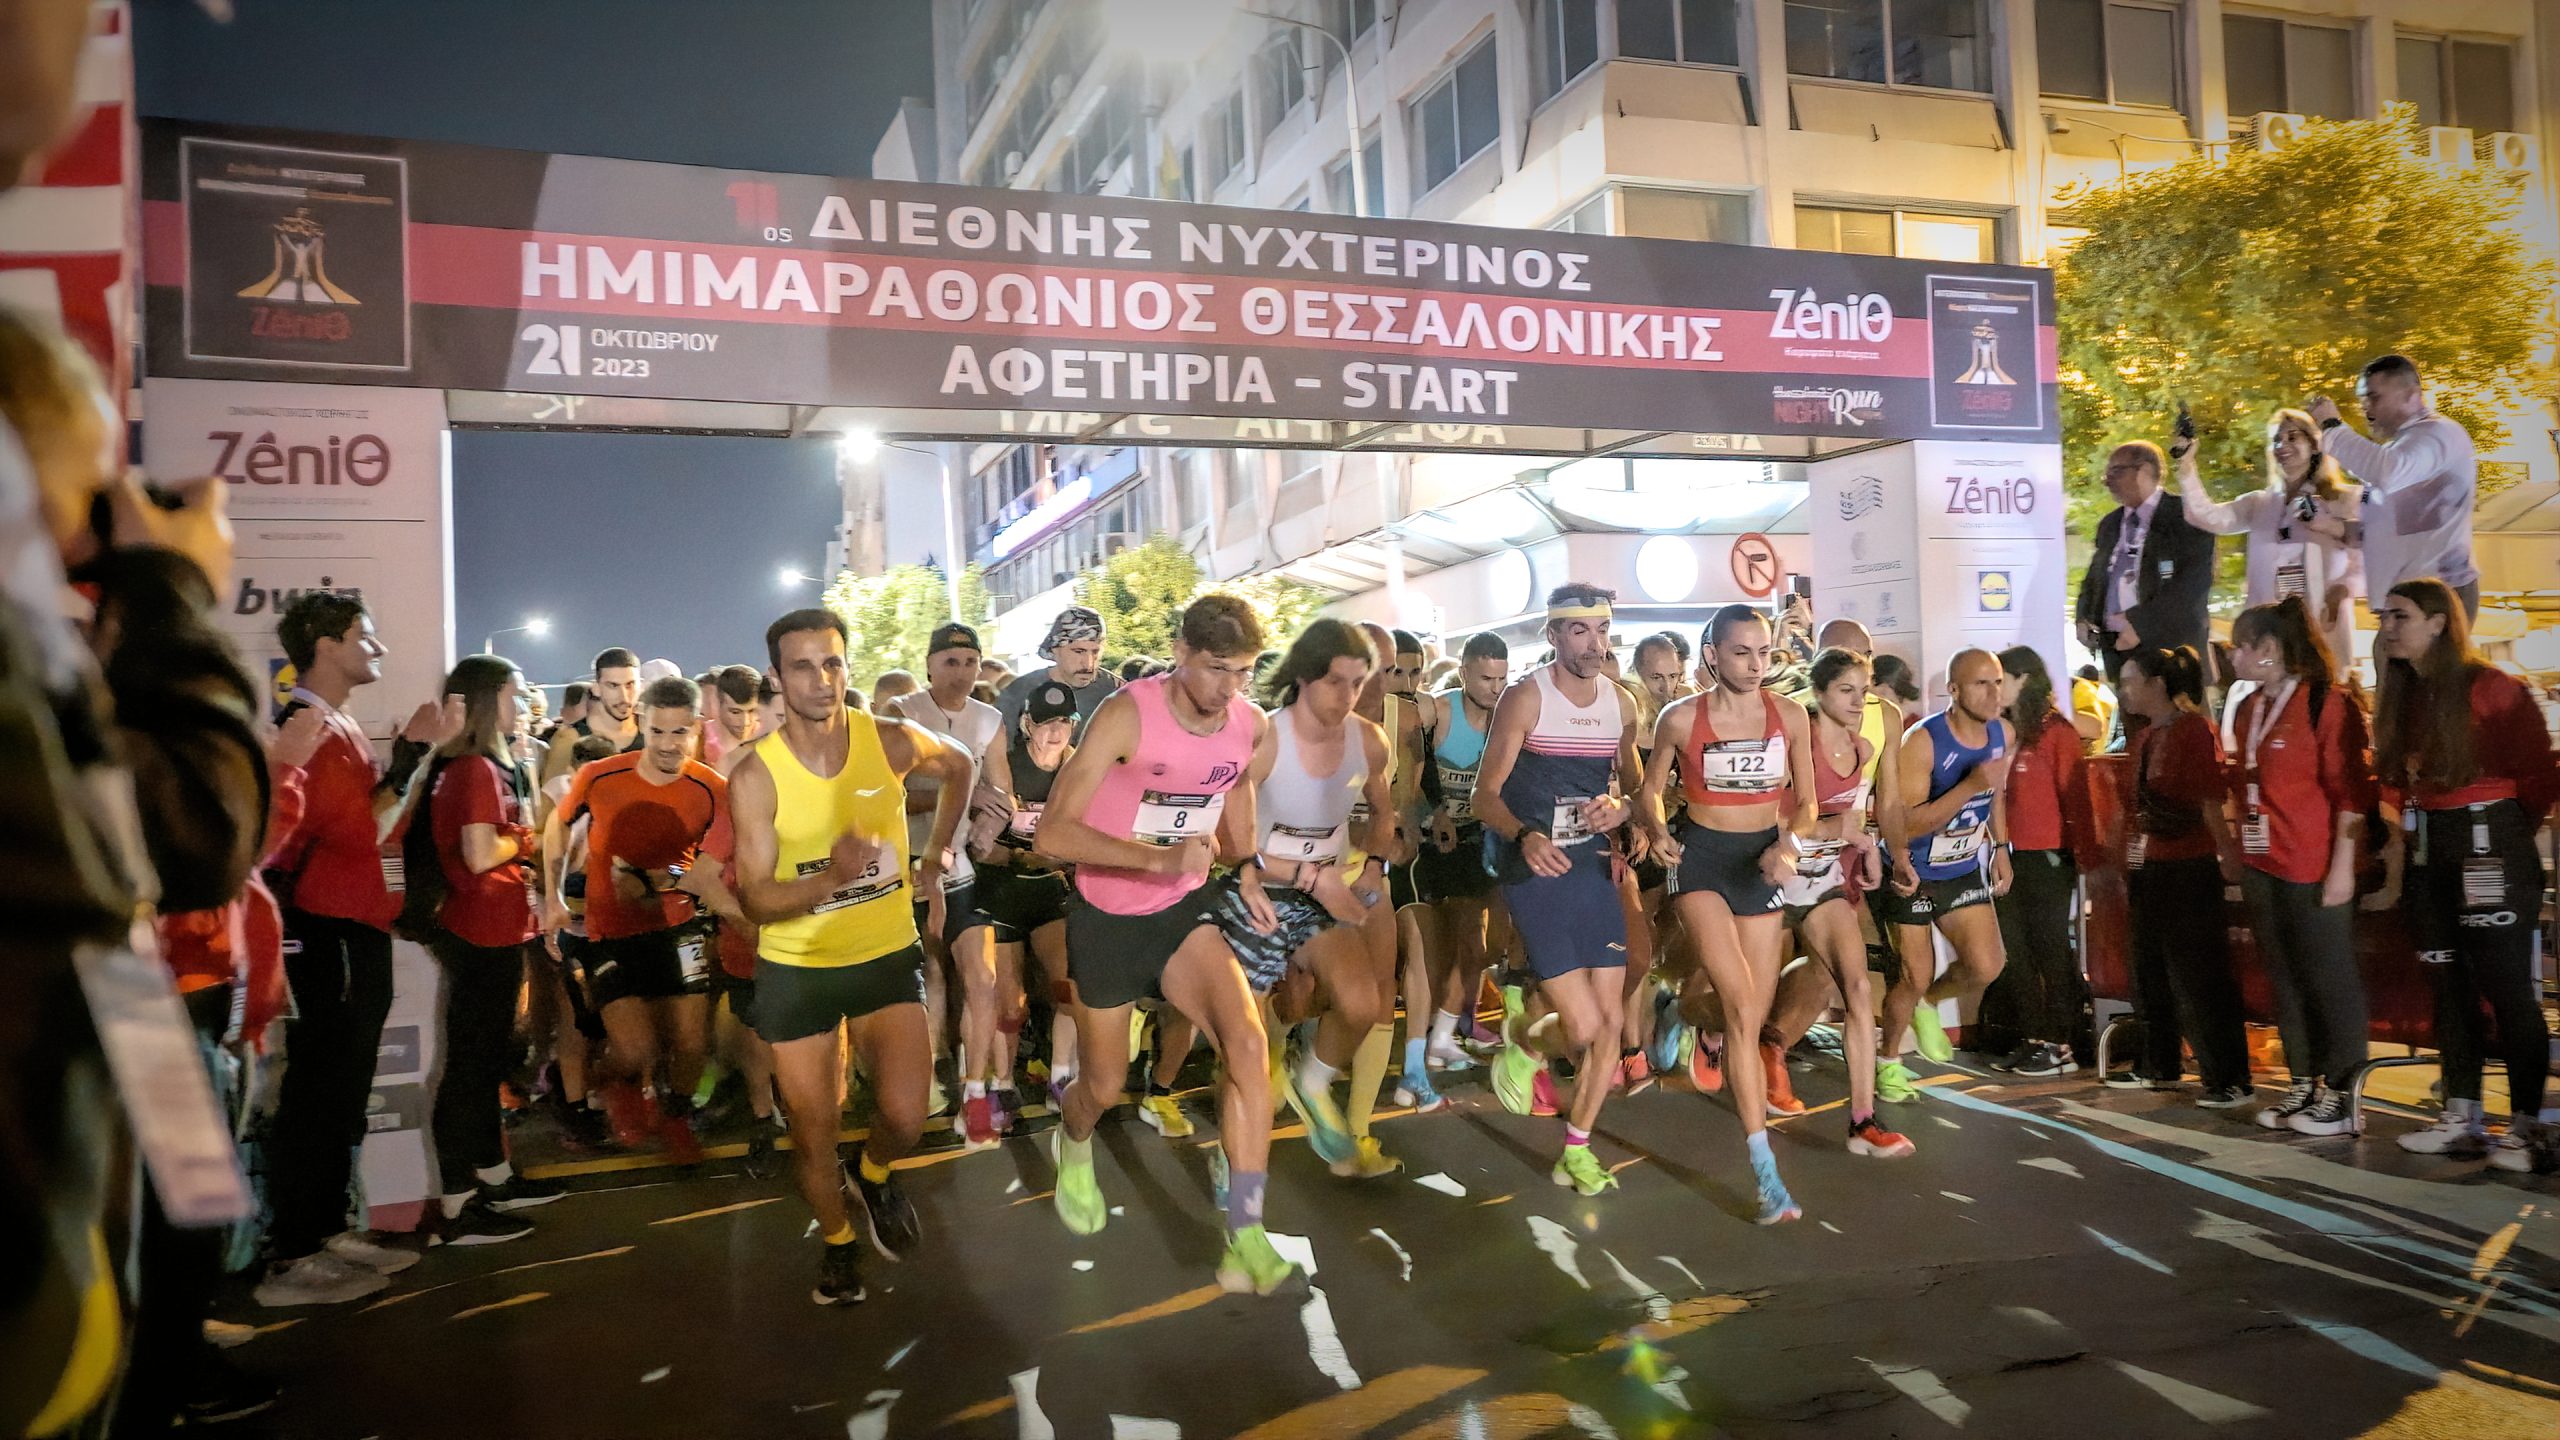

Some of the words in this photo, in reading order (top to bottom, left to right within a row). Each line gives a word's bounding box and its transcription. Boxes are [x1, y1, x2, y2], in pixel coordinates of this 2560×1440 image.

[809, 195, 1152, 259] ΔΙΕΘΝΗΣ
[1180, 221, 1591, 291] ΝΥΧΤΕΡΙΝΟΣ
[521, 241, 1217, 332] ΗΜΙΜΑΡΑΘΩΝΙΟΣ
[1241, 286, 1723, 361] ΘΕΣΣΑΛΟΝΙΚΗΣ
[520, 323, 582, 376] 21
[590, 328, 719, 352] ΟΚΤΩΒΡΙΟΥ
[591, 357, 650, 377] 2023
[940, 345, 1276, 403] ΑΦΕΤΗΡΙΑ
[1342, 363, 1518, 415] START
[1727, 756, 1765, 773] 122
[1174, 811, 1188, 828] 8
[1952, 838, 1968, 850] 41
